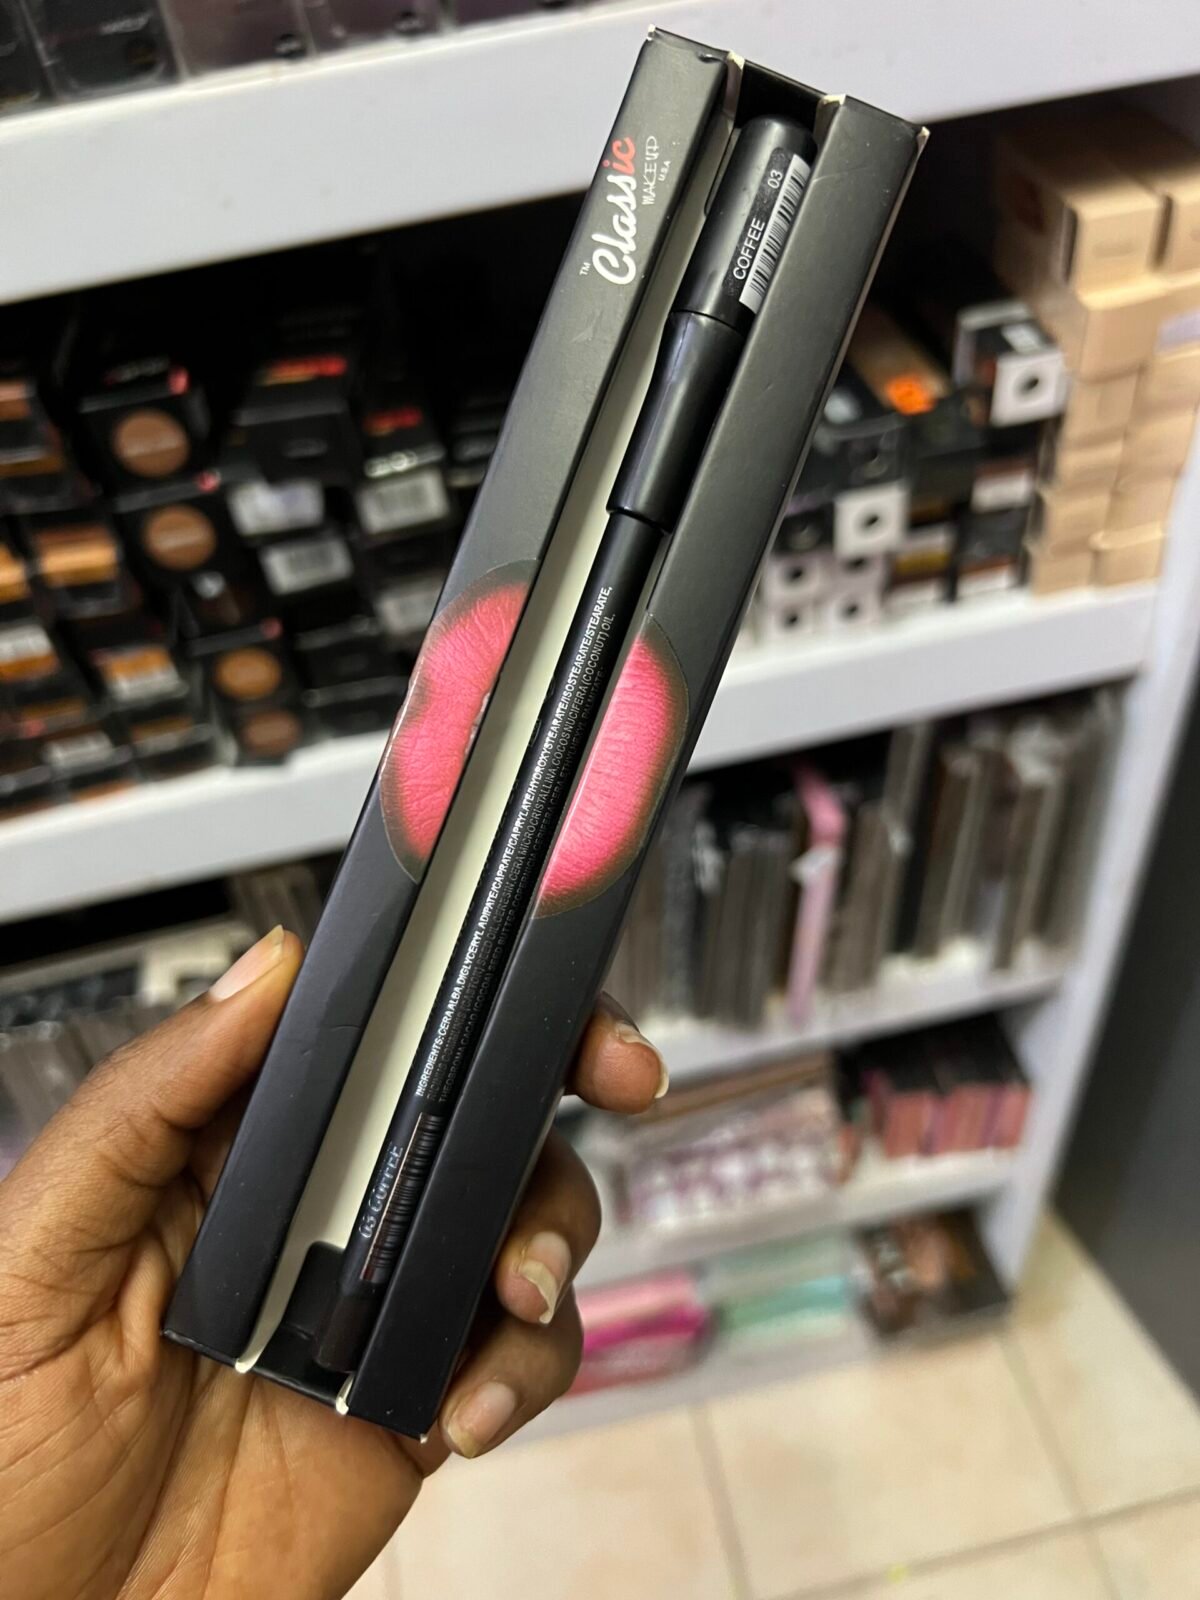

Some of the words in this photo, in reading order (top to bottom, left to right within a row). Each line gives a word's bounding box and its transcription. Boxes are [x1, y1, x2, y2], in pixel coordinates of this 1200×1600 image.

[591, 136, 637, 286] Classic
[733, 218, 766, 281] COFFEE
[767, 168, 783, 190] 03
[563, 683, 588, 732] NUCIFERA
[580, 630, 610, 686] (COCONUT)
